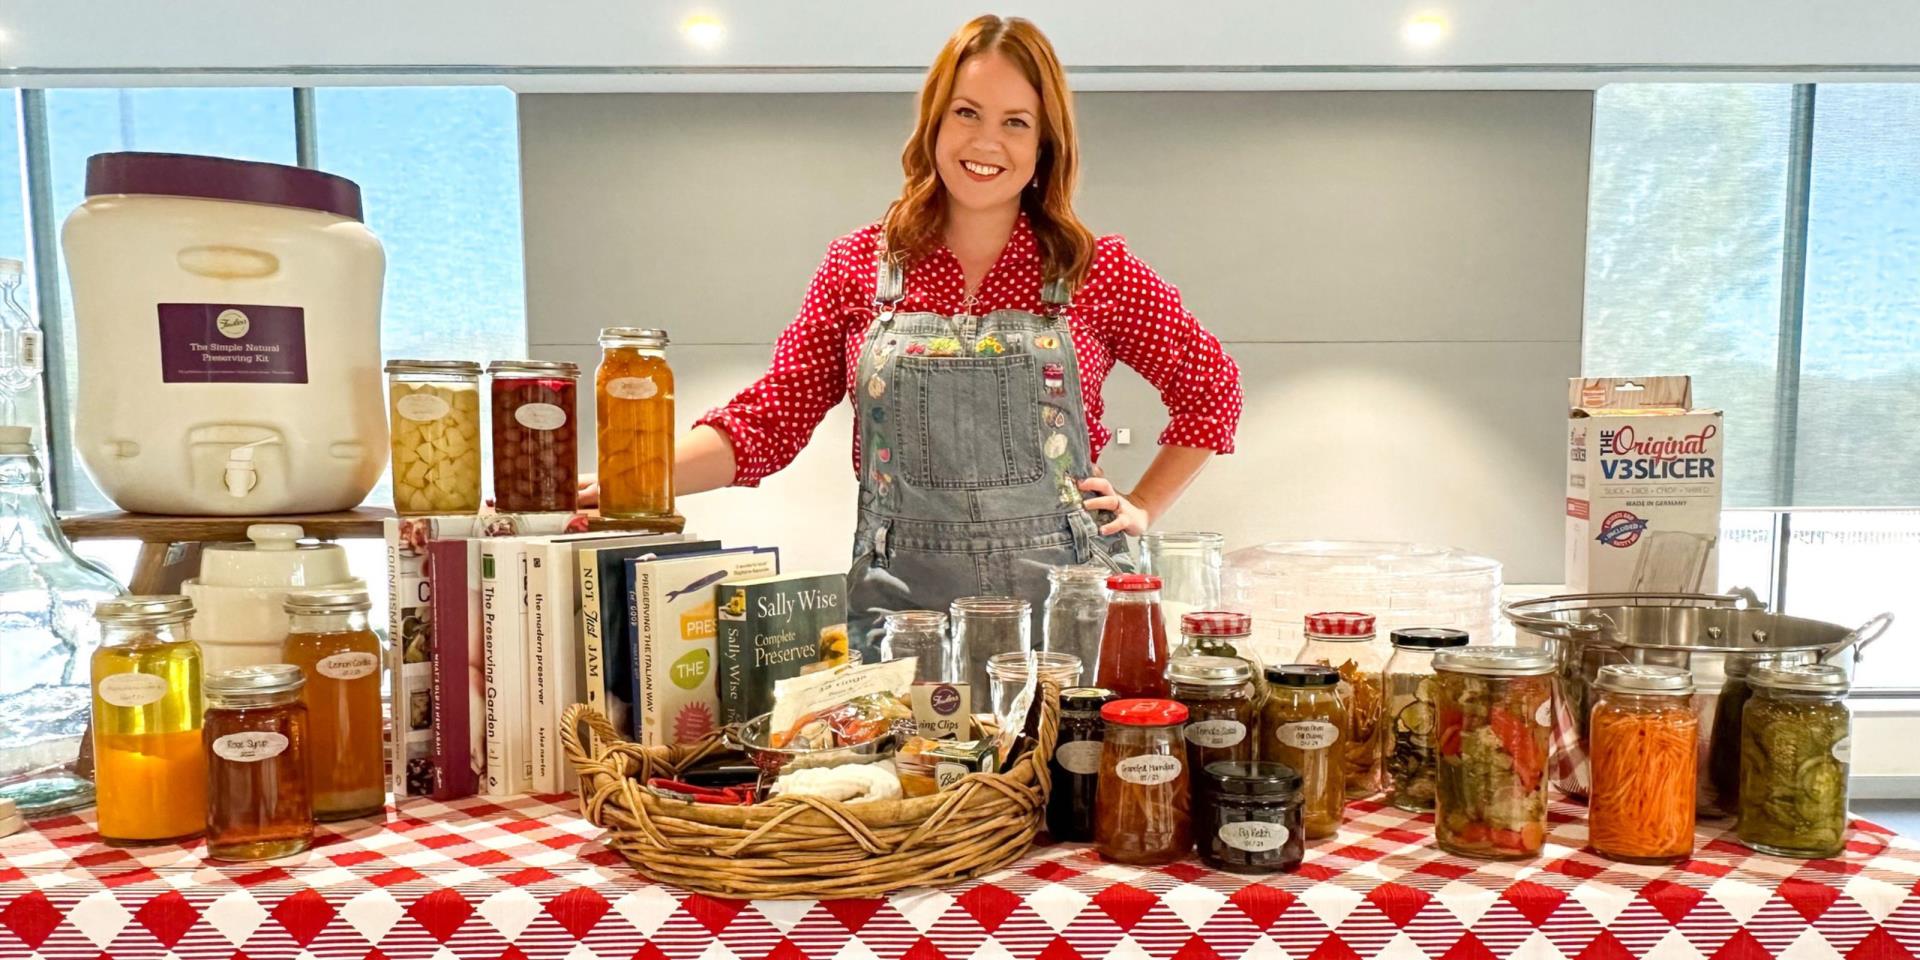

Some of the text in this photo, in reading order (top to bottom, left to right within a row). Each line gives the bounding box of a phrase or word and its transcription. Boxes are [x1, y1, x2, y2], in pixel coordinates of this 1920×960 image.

[189, 342, 280, 353] The Simple Natural
[202, 353, 270, 363] Preserving Kit
[1600, 430, 1615, 456] THE
[1612, 424, 1717, 466] Original
[1600, 457, 1715, 480] V3SLICER
[388, 546, 398, 647] CORNERSMITH
[757, 589, 837, 623] Sally Wise
[583, 568, 599, 677] NOT Just JAM
[754, 629, 796, 648] Complete
[535, 594, 544, 705] the modern preserver
[642, 573, 654, 713] PRESERVING THE ITALIAN WAY
[724, 628, 740, 661] Sally
[755, 643, 816, 667] Preserves
[485, 587, 498, 738] The Preserving Garden
[676, 661, 705, 679] THE
[729, 664, 740, 700] Wise
[937, 719, 959, 731] Clips
